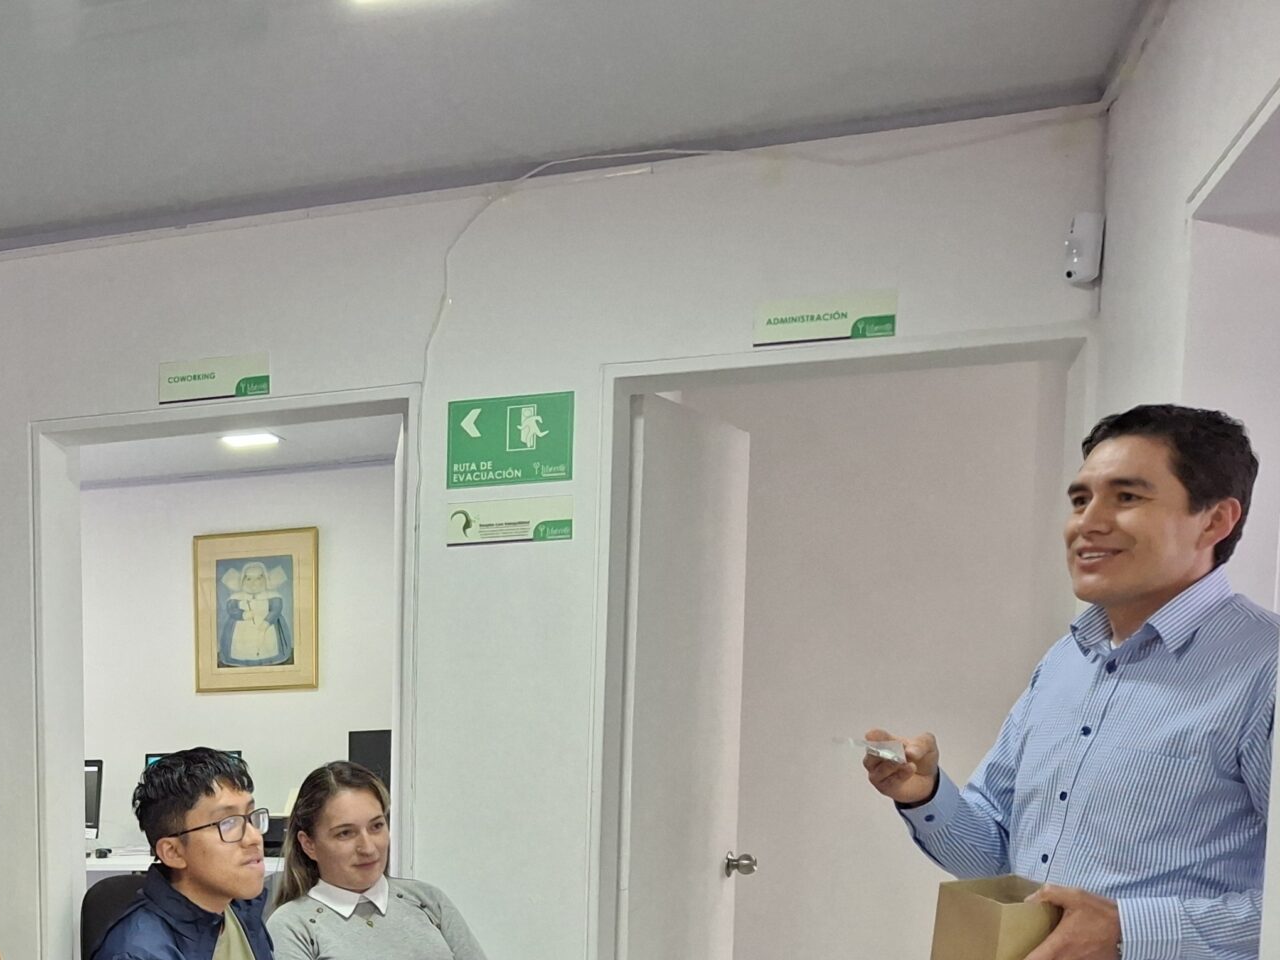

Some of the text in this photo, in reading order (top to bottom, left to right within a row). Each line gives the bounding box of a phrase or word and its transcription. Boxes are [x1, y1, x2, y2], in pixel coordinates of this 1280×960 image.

[766, 310, 848, 326] ADMINISTRACIÓN
[167, 372, 216, 384] COWORKING
[453, 461, 493, 472] RUTA DE
[453, 467, 522, 482] EVACUACIÓN
